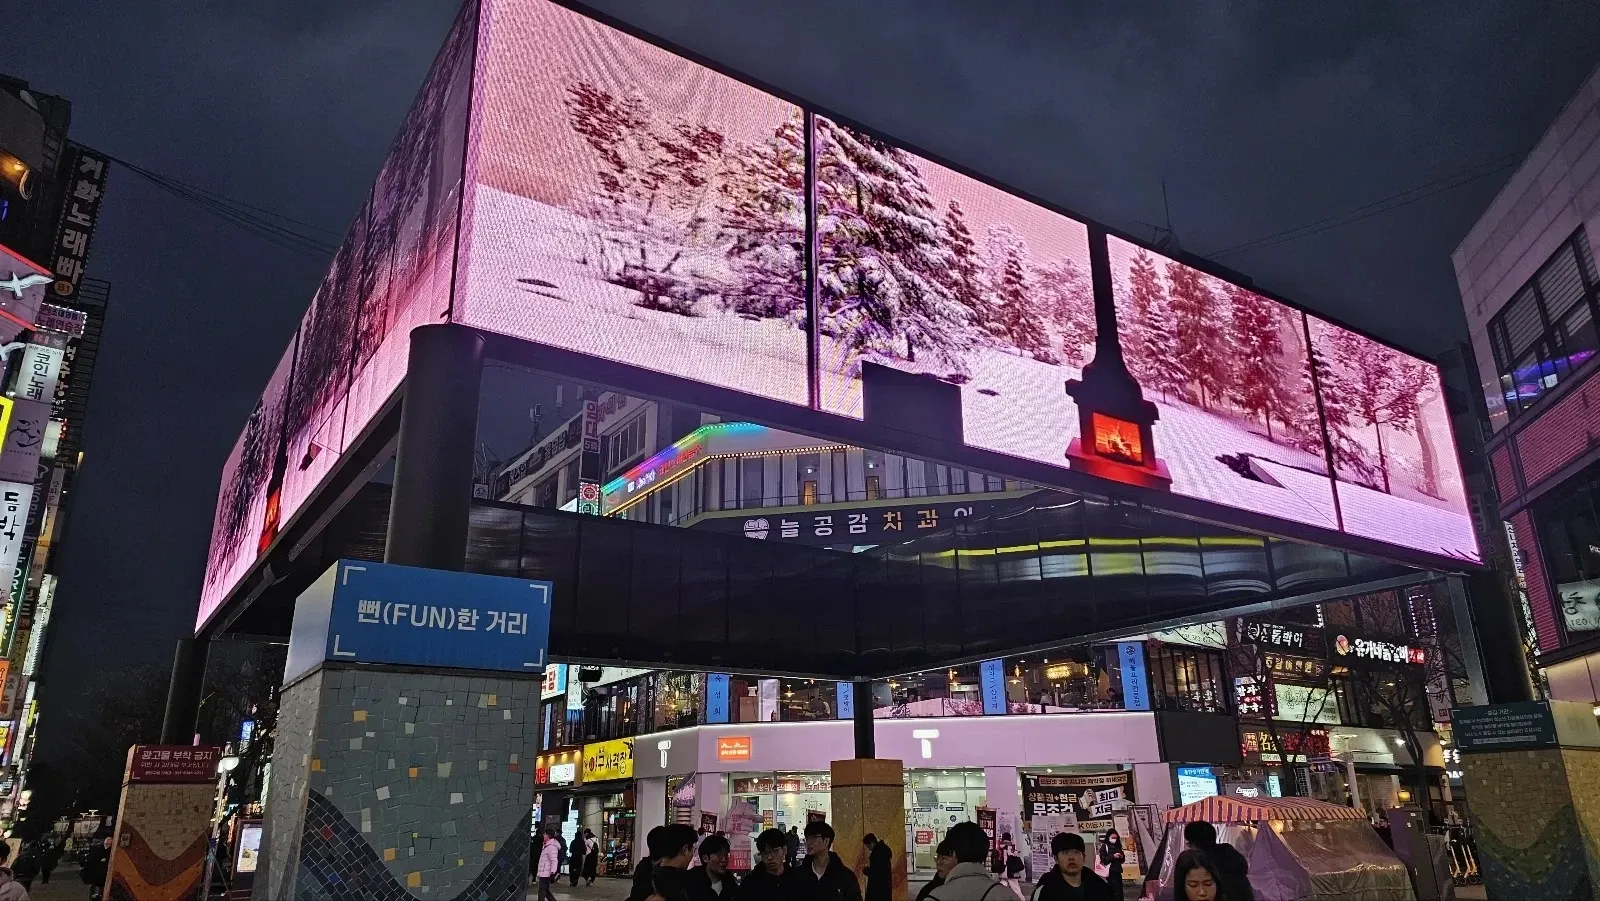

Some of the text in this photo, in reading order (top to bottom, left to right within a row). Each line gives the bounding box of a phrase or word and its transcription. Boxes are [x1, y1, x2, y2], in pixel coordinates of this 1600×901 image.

[26, 352, 51, 401] 코인노래
[586, 401, 599, 438] 임대
[358, 600, 528, 634] 뻔(FUN)한 거리
[141, 750, 212, 760] 광고물 부착 금지
[912, 728, 940, 759] T
[588, 751, 627, 775] 야구사격장
[1028, 792, 1078, 803] 상품권+현금
[1099, 789, 1119, 802] 최대
[1095, 803, 1113, 815] 지급
